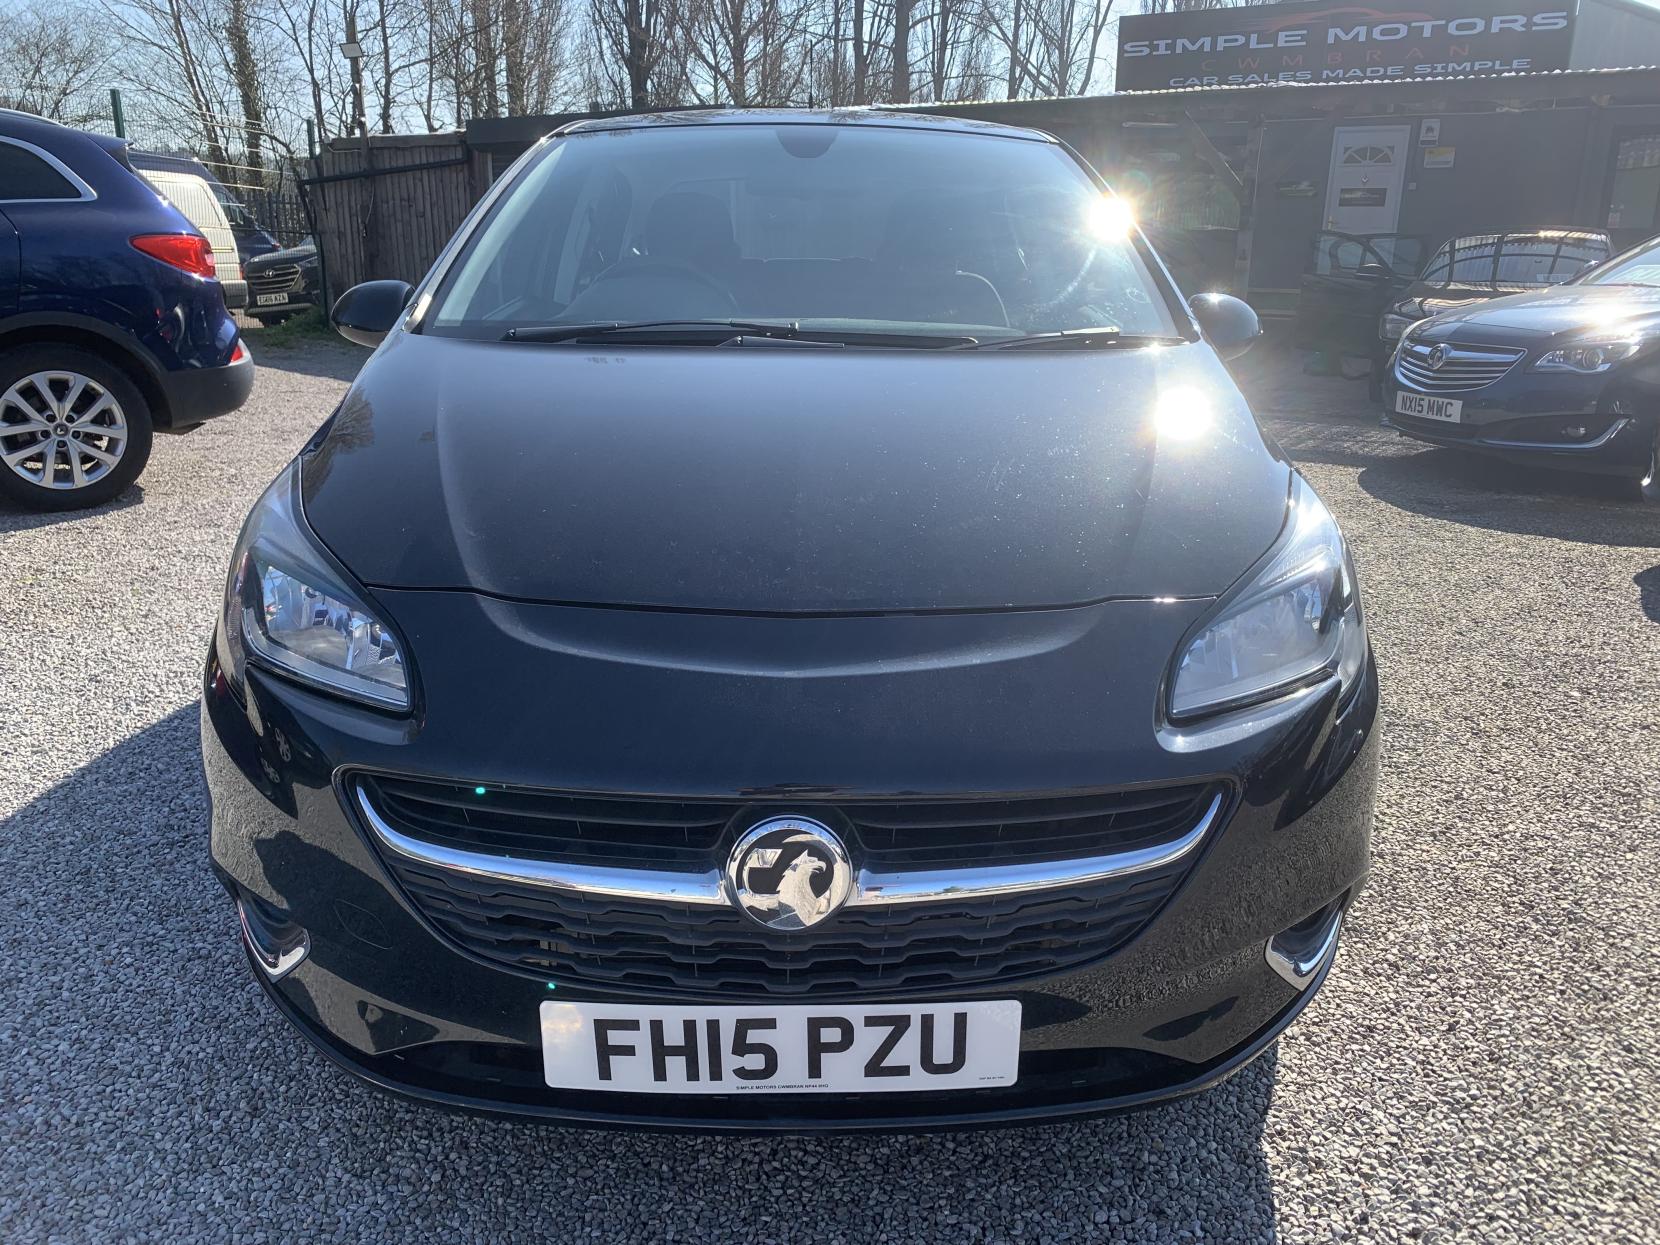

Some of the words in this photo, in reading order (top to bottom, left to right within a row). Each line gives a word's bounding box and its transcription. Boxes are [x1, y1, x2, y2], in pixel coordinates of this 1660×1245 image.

[1123, 30, 1307, 57] SIMPLE
[1327, 12, 1568, 45] MOTORS
[1202, 44, 1469, 71] CWMBRAN
[1169, 76, 1219, 87] CAR
[1227, 71, 1312, 84] SALES
[1322, 66, 1404, 79] MADE
[1414, 58, 1532, 74] SIMPLE
[1401, 394, 1425, 414] NX15
[1427, 399, 1454, 418] MWC
[593, 1018, 779, 1082] FH15
[807, 1012, 967, 1079] PZU
